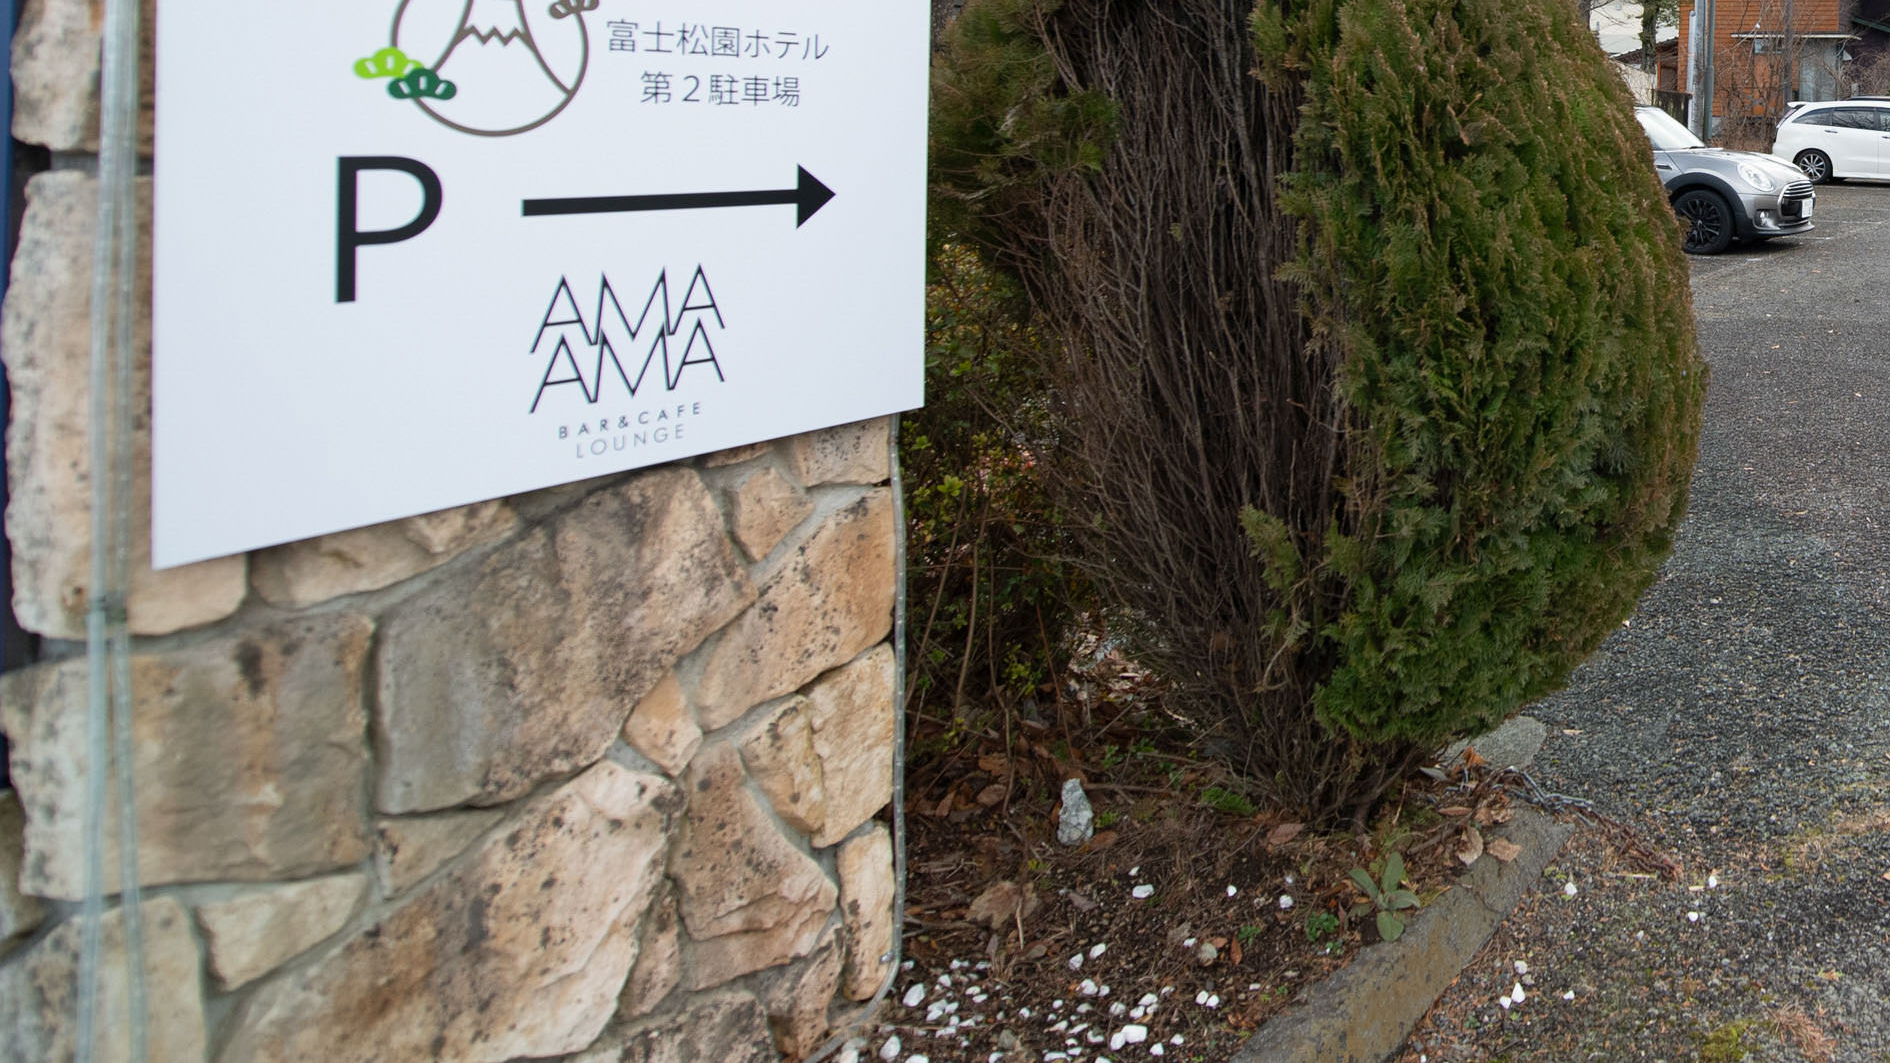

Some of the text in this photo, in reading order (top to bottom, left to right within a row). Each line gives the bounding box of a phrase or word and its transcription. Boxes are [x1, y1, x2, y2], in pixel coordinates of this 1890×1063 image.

[606, 17, 830, 61] 富士松園ホテル
[640, 70, 801, 108] 第2駐車場
[335, 155, 443, 304] P
[530, 263, 726, 354] AMA
[529, 317, 726, 414] AMA
[576, 424, 685, 459] LOUNGE
